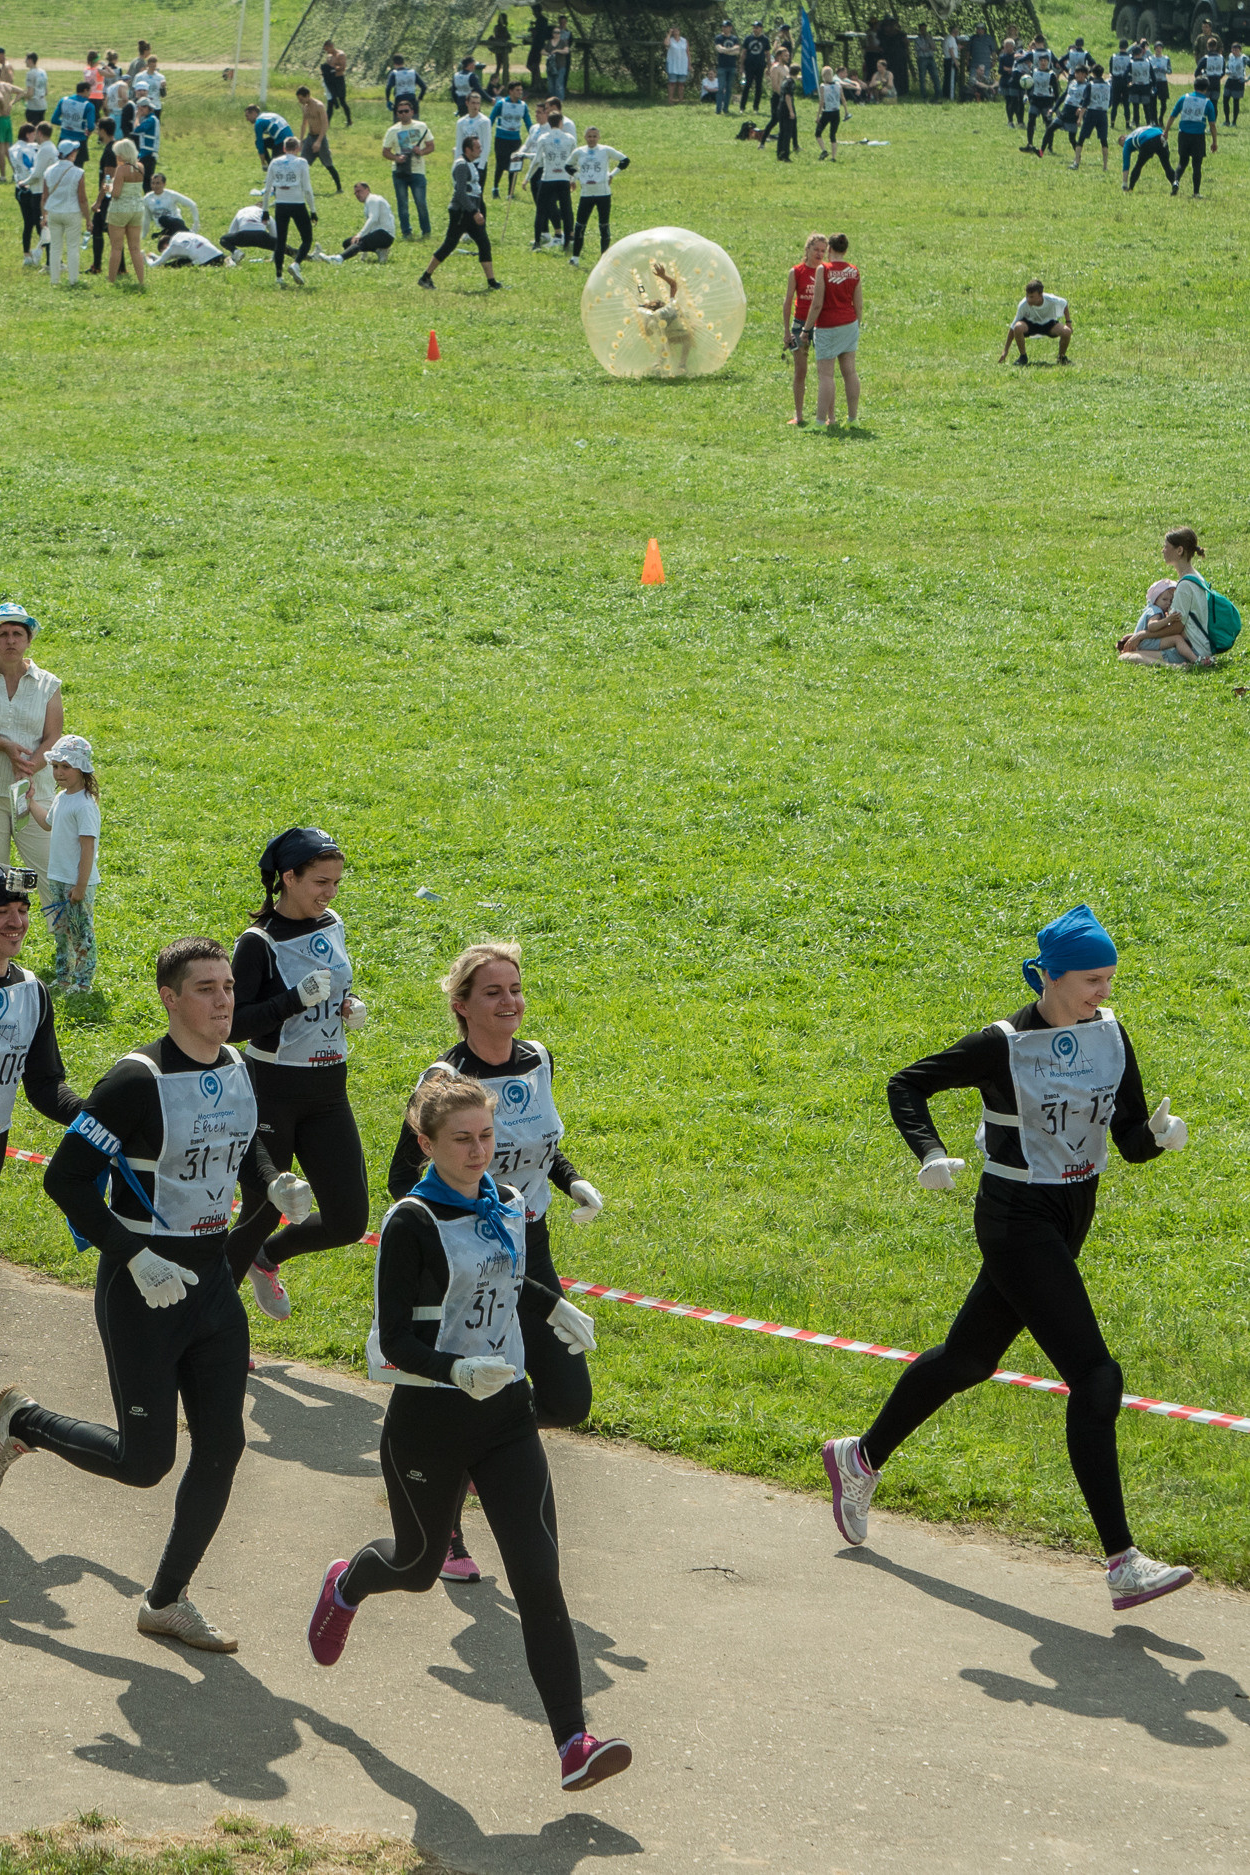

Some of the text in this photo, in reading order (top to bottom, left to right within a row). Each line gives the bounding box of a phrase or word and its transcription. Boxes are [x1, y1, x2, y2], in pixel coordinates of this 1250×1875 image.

[315, 1049, 339, 1059] ГОНК
[1050, 1068, 1094, 1079] Мосгортранс
[197, 1109, 235, 1121] Мосгортранс
[1041, 1092, 1114, 1136] 31-12
